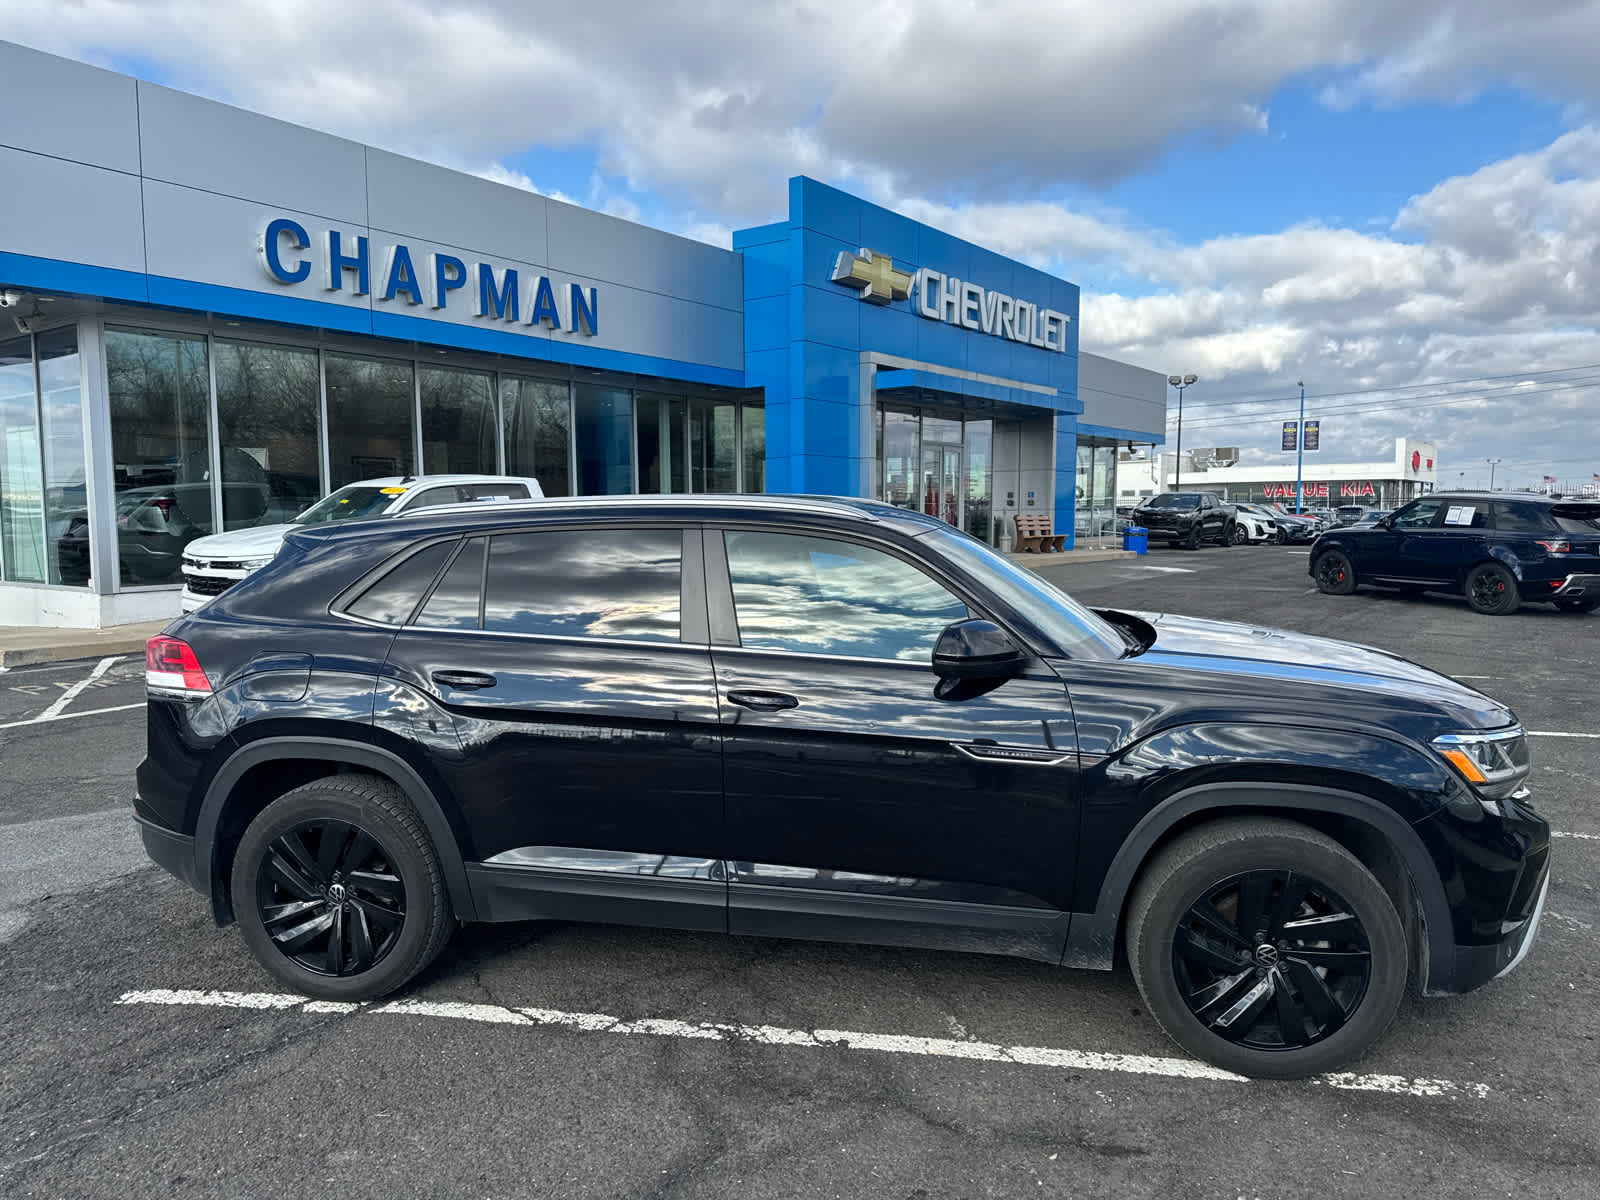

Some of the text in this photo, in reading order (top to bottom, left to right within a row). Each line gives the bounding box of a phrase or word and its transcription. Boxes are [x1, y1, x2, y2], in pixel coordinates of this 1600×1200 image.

[261, 218, 598, 337] CHAPMAN
[915, 267, 1071, 352] CHEVROLET
[1263, 480, 1376, 497] VALUE KIA
